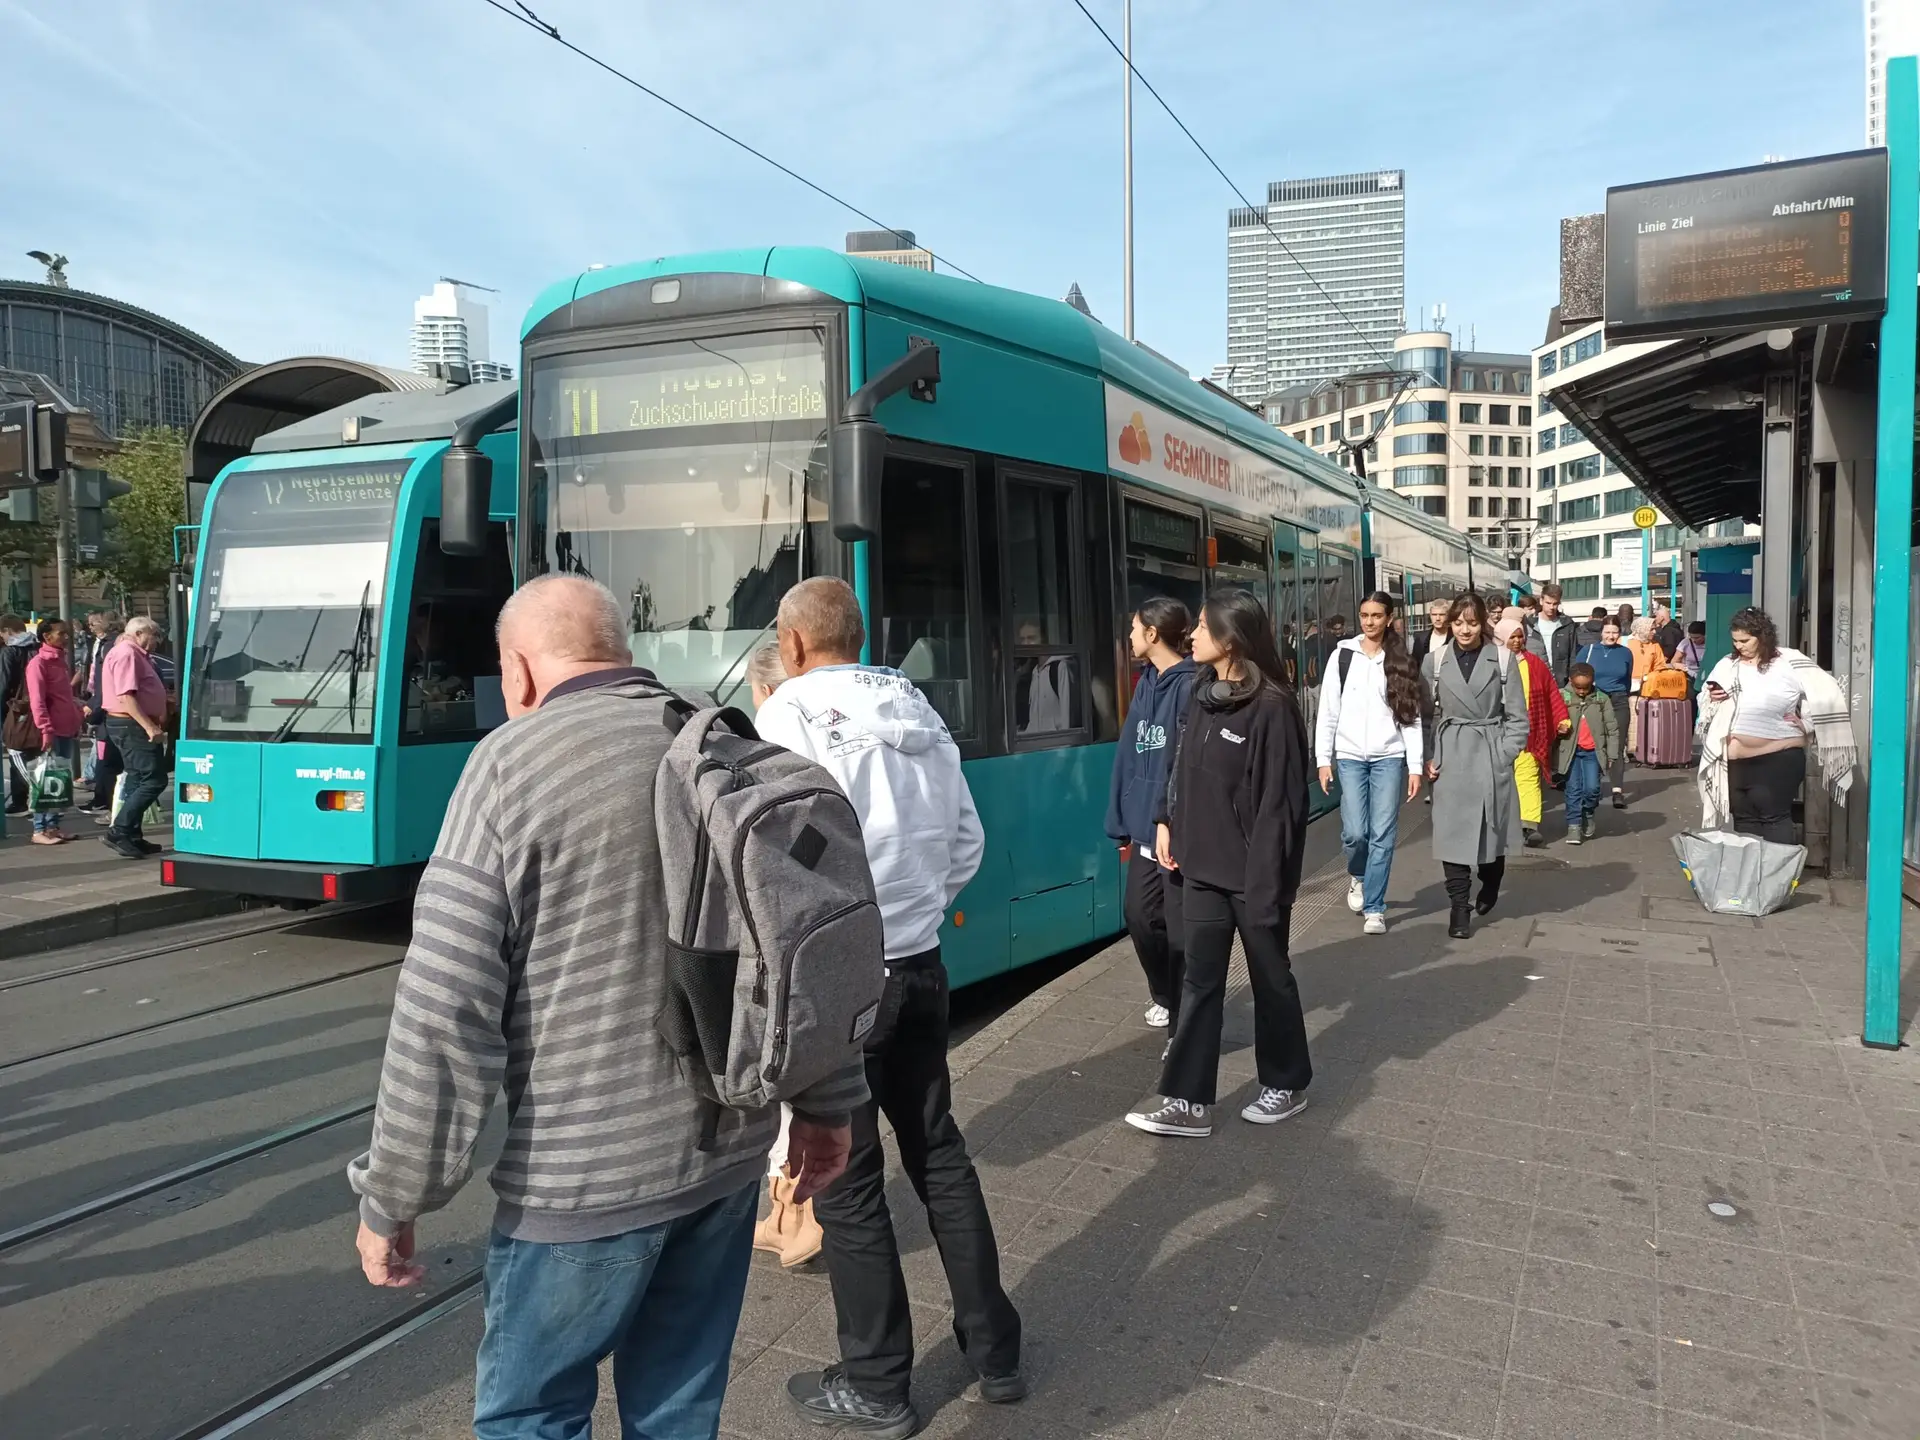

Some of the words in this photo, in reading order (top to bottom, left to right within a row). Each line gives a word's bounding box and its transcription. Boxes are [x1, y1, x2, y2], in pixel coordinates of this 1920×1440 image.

[1772, 195, 1855, 216] Abfahrt/Min
[1638, 220, 1667, 235] Linie
[1671, 216, 1694, 230] Ziel
[629, 384, 823, 428] Zuckschwerdtstraße
[1163, 431, 1232, 492] SEGMÜLLER
[306, 487, 393, 503] Stadtgrenze
[1638, 512, 1653, 523] HH
[295, 767, 367, 782] www.vgf-ffm.de
[178, 812, 194, 830] 002
[195, 814, 204, 831] A
